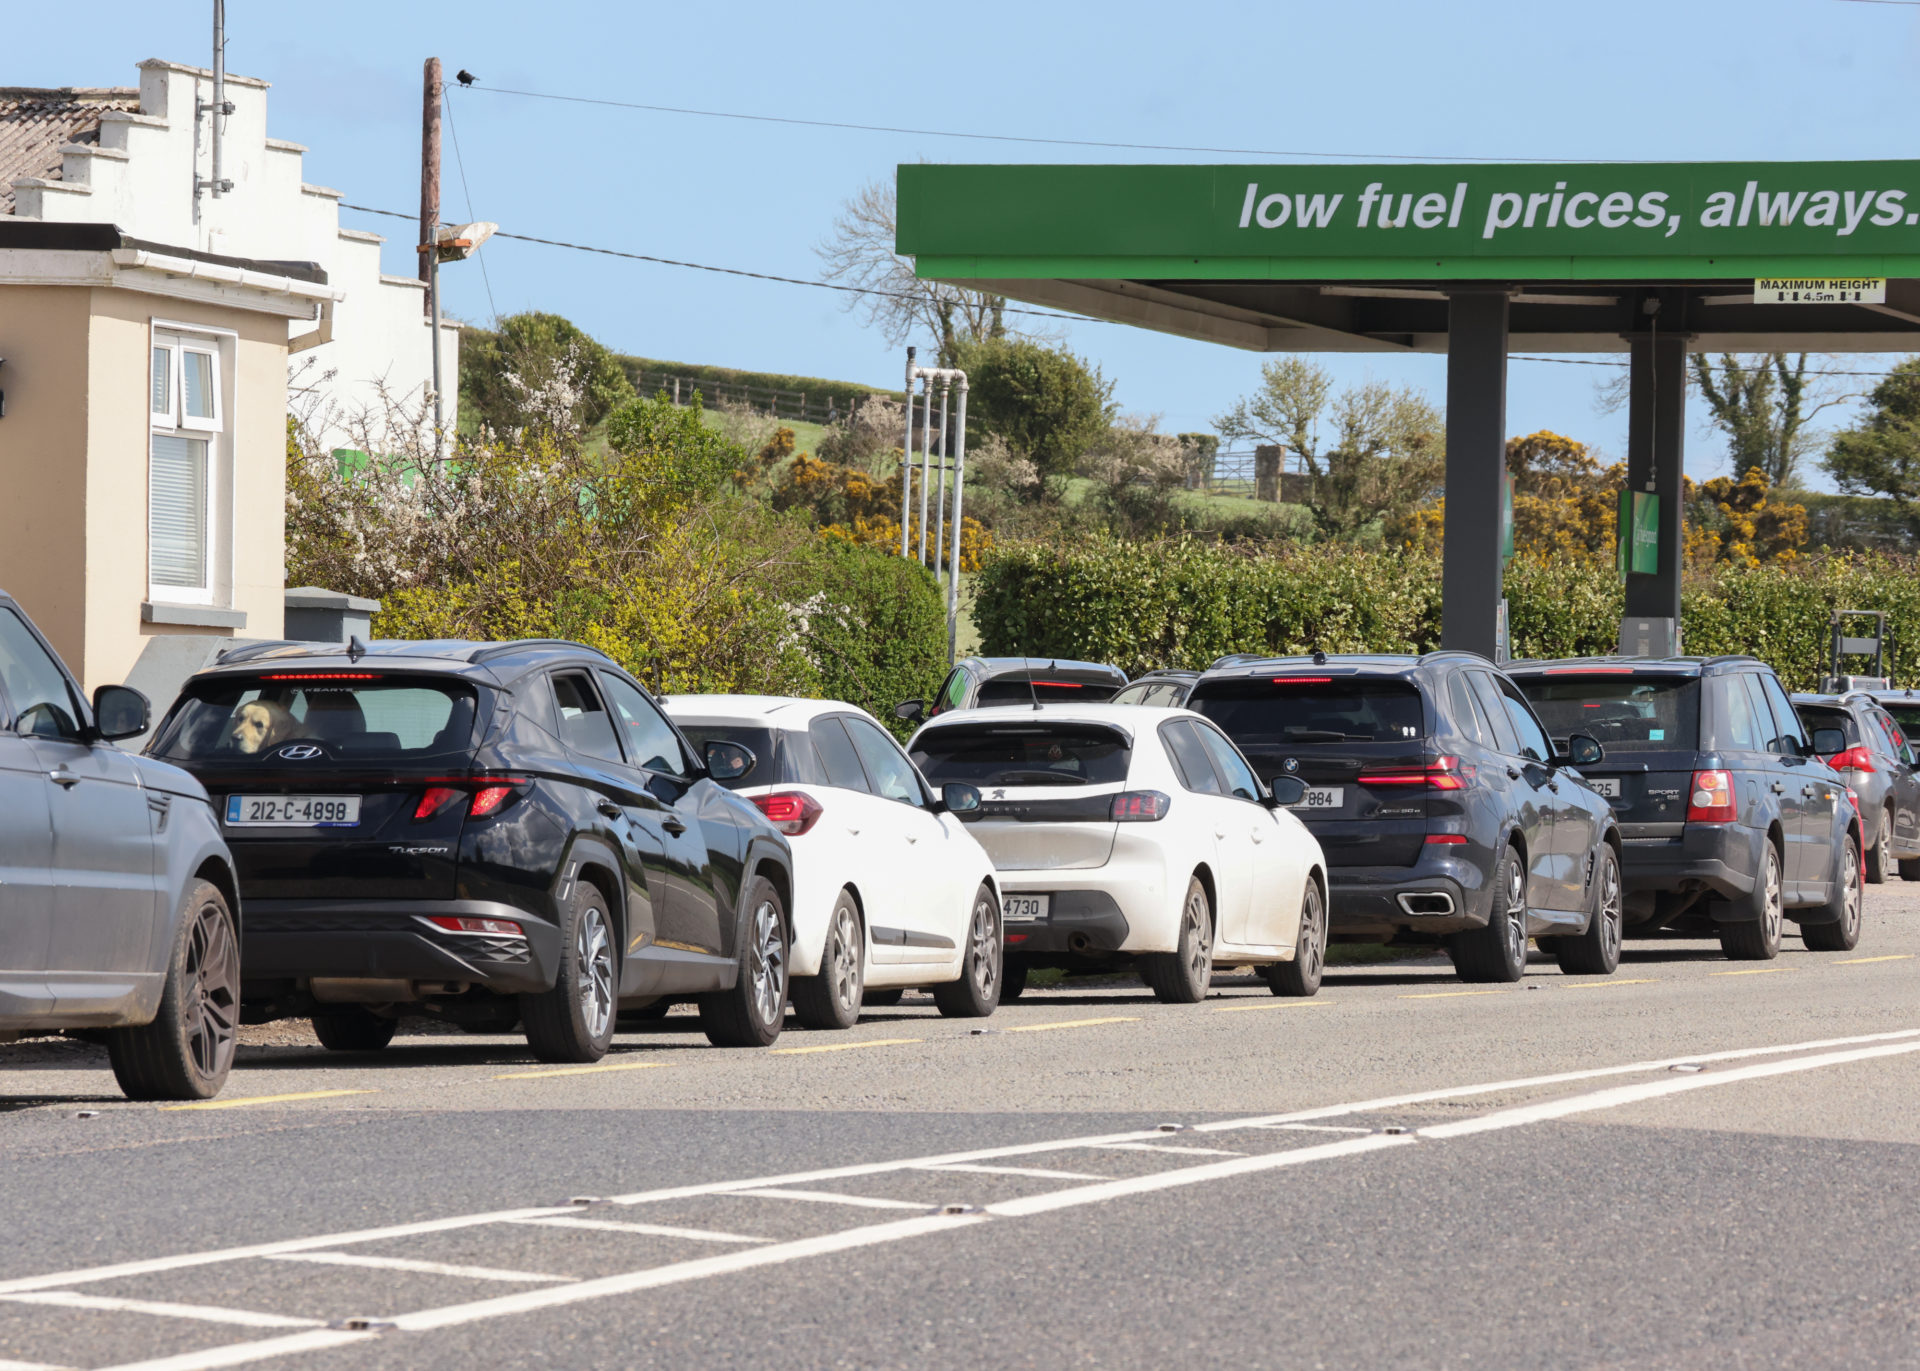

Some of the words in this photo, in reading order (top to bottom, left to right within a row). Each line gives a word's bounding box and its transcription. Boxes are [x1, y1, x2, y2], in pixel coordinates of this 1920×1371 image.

[1238, 182, 1344, 229] low
[1356, 182, 1468, 229] fuel
[1482, 181, 1681, 239] prices,
[1699, 180, 1919, 237] always.
[1760, 280, 1825, 290] MAXIMUM
[1829, 280, 1880, 290] HEIGHT
[1803, 292, 1835, 302] 4.5m
[249, 801, 347, 820] 212-C-4898
[1003, 899, 1039, 915] 4730
